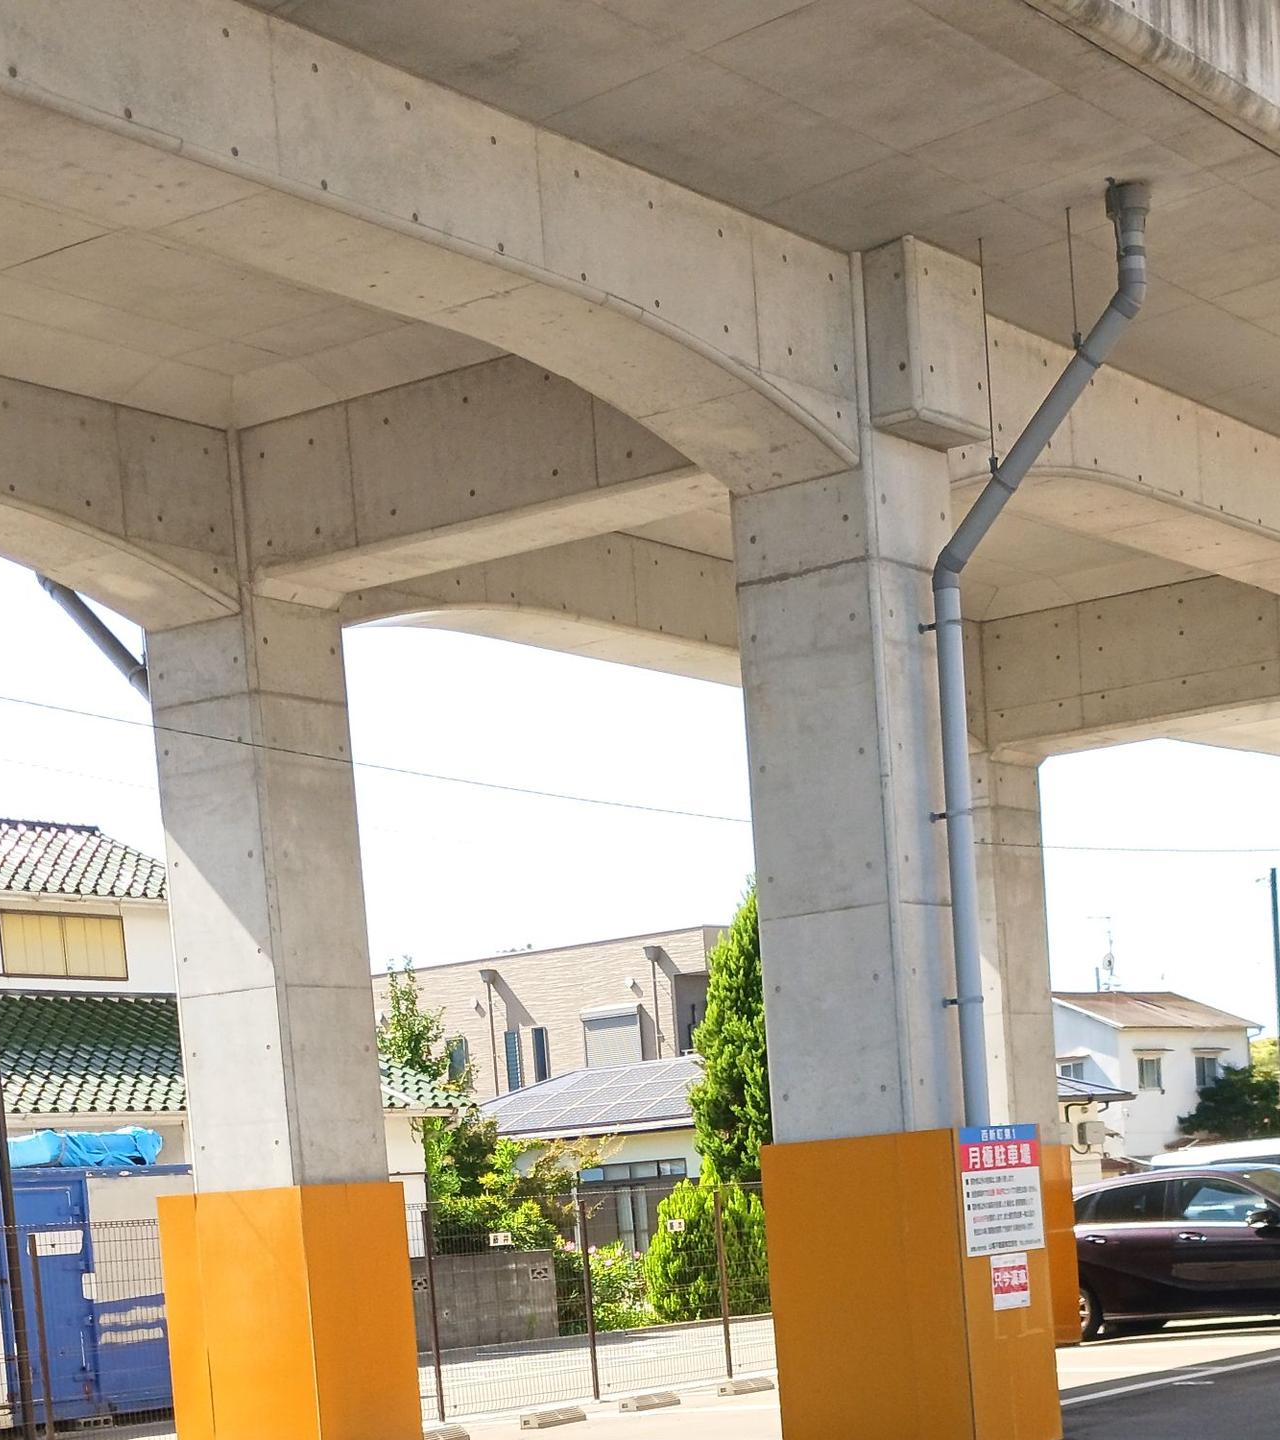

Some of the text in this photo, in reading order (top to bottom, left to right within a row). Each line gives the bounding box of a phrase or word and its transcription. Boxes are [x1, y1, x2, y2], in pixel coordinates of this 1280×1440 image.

[968, 1143, 1032, 1169] 月極駐車場
